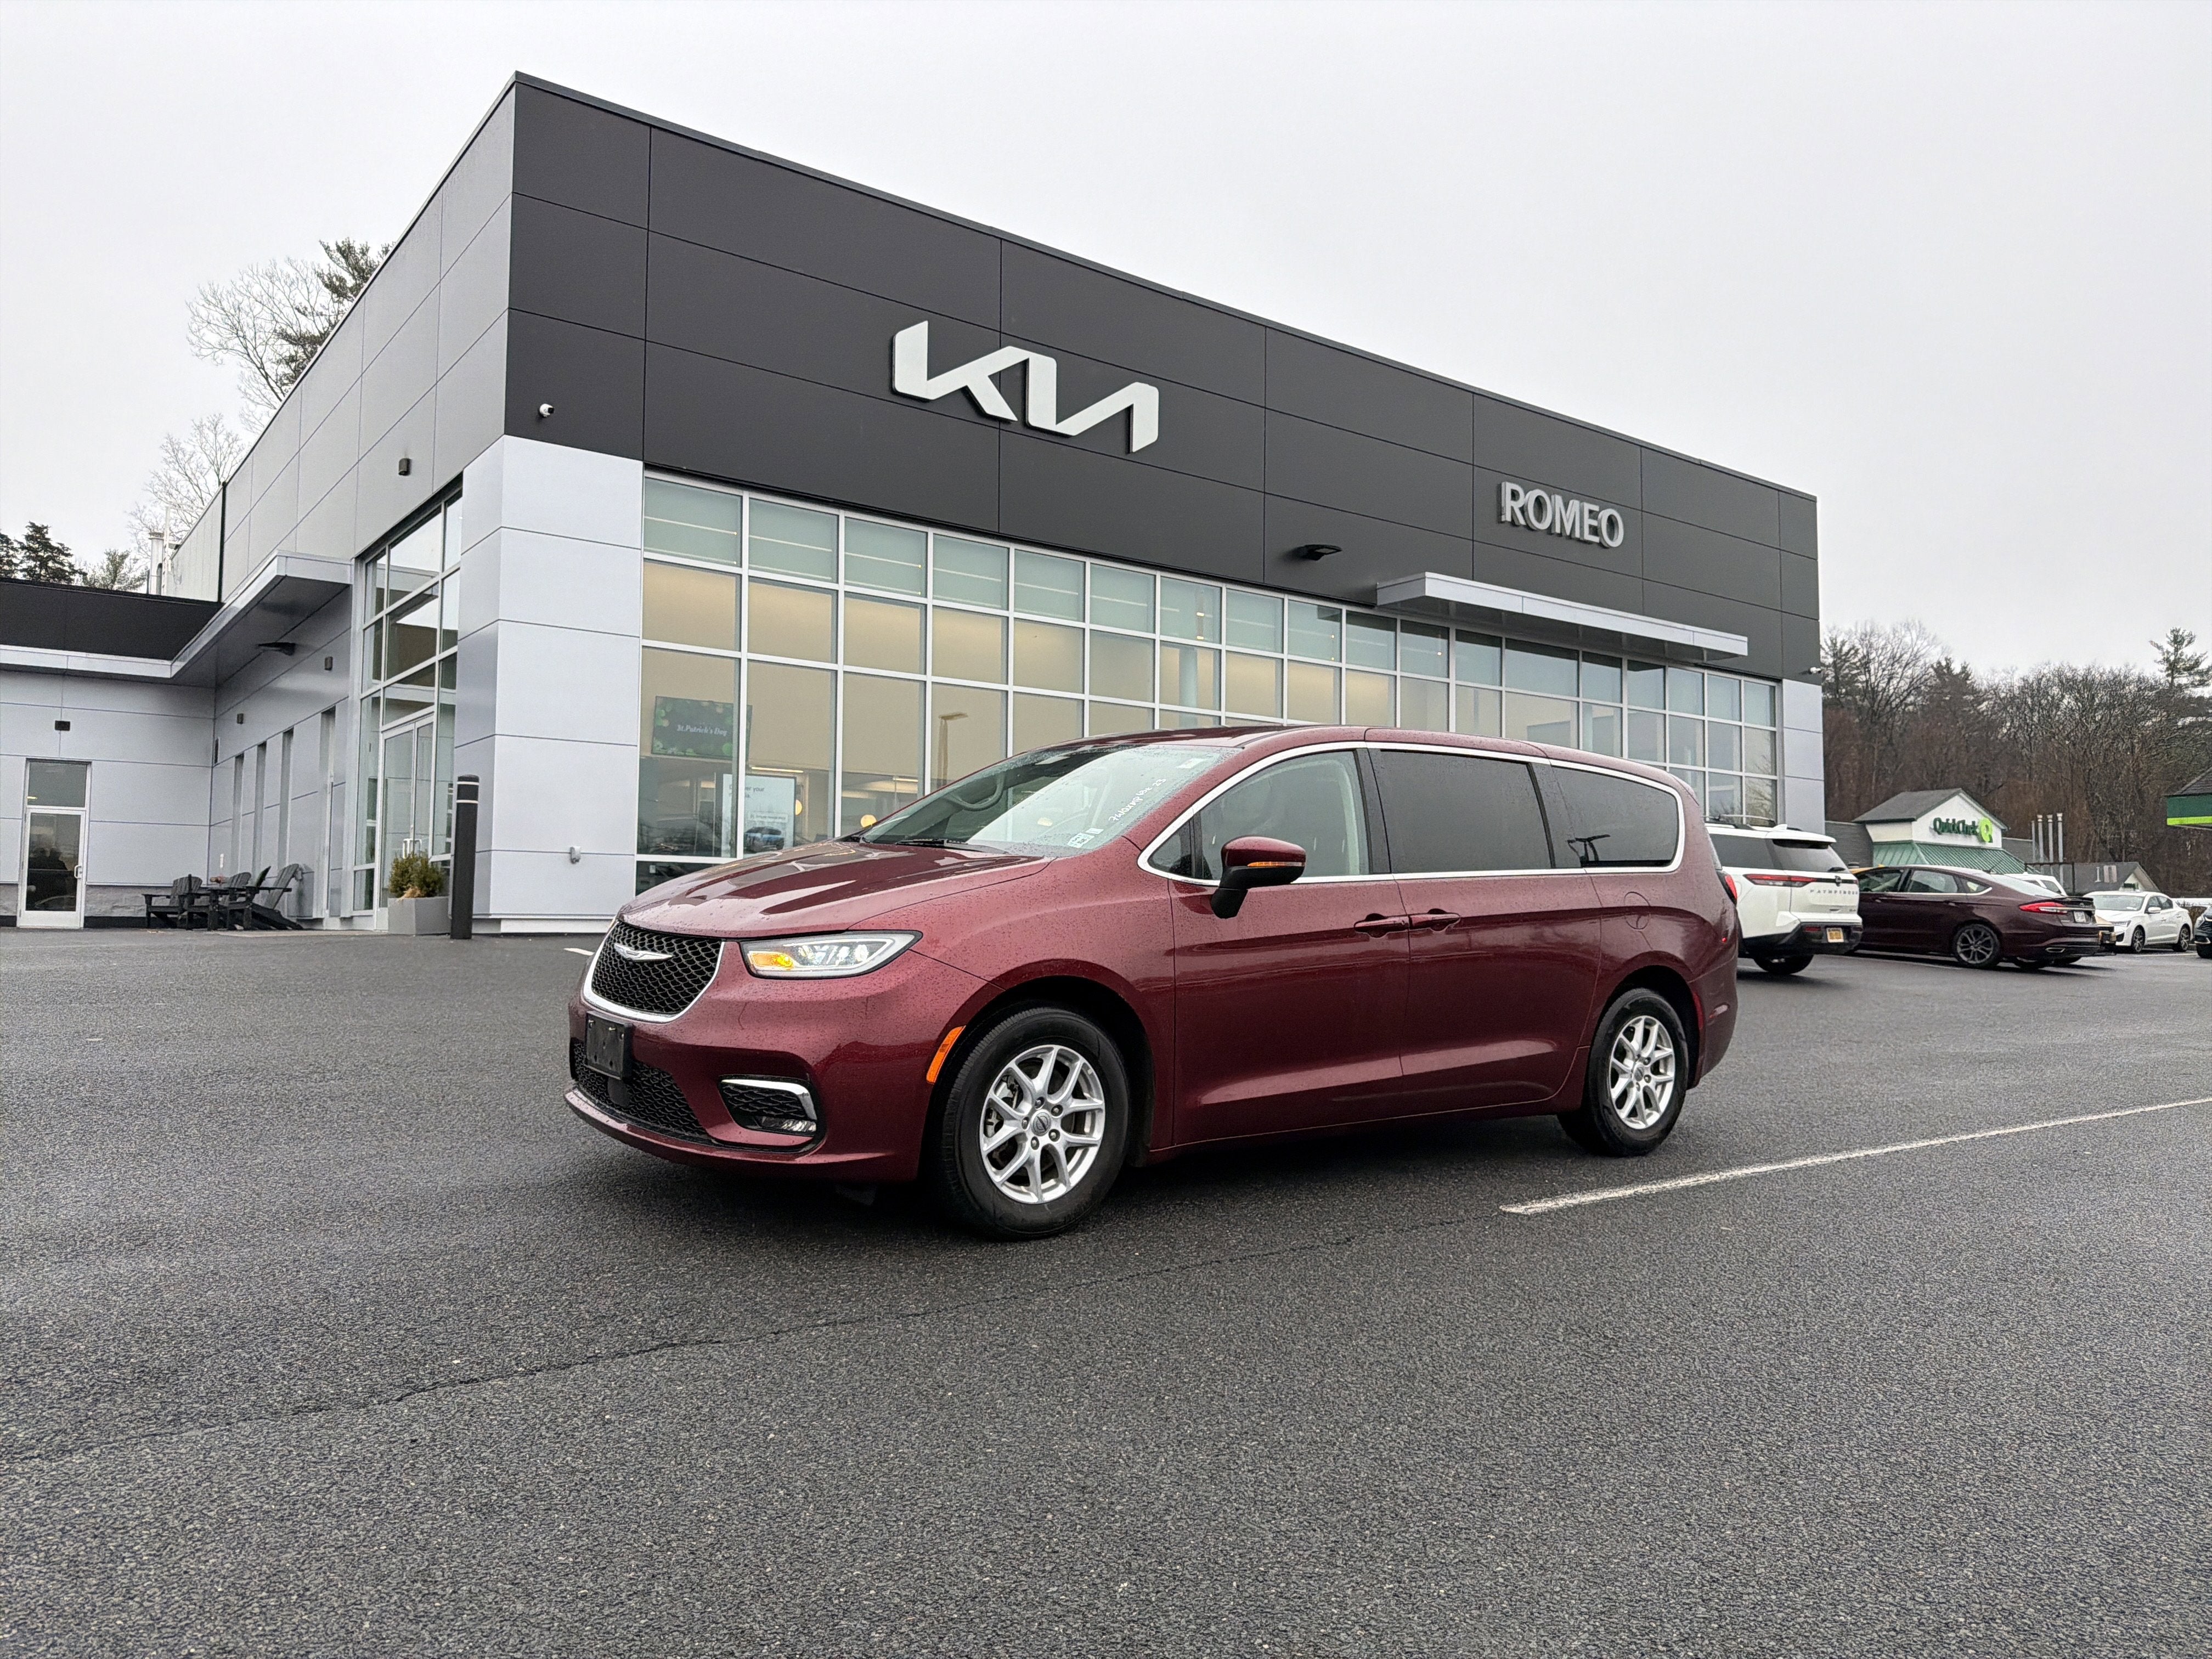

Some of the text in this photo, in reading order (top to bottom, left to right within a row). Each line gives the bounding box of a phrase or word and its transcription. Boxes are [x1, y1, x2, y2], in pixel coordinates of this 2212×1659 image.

[893, 320, 1159, 453] KIA
[1500, 481, 1624, 548] ROMEO
[714, 727, 728, 737] Day
